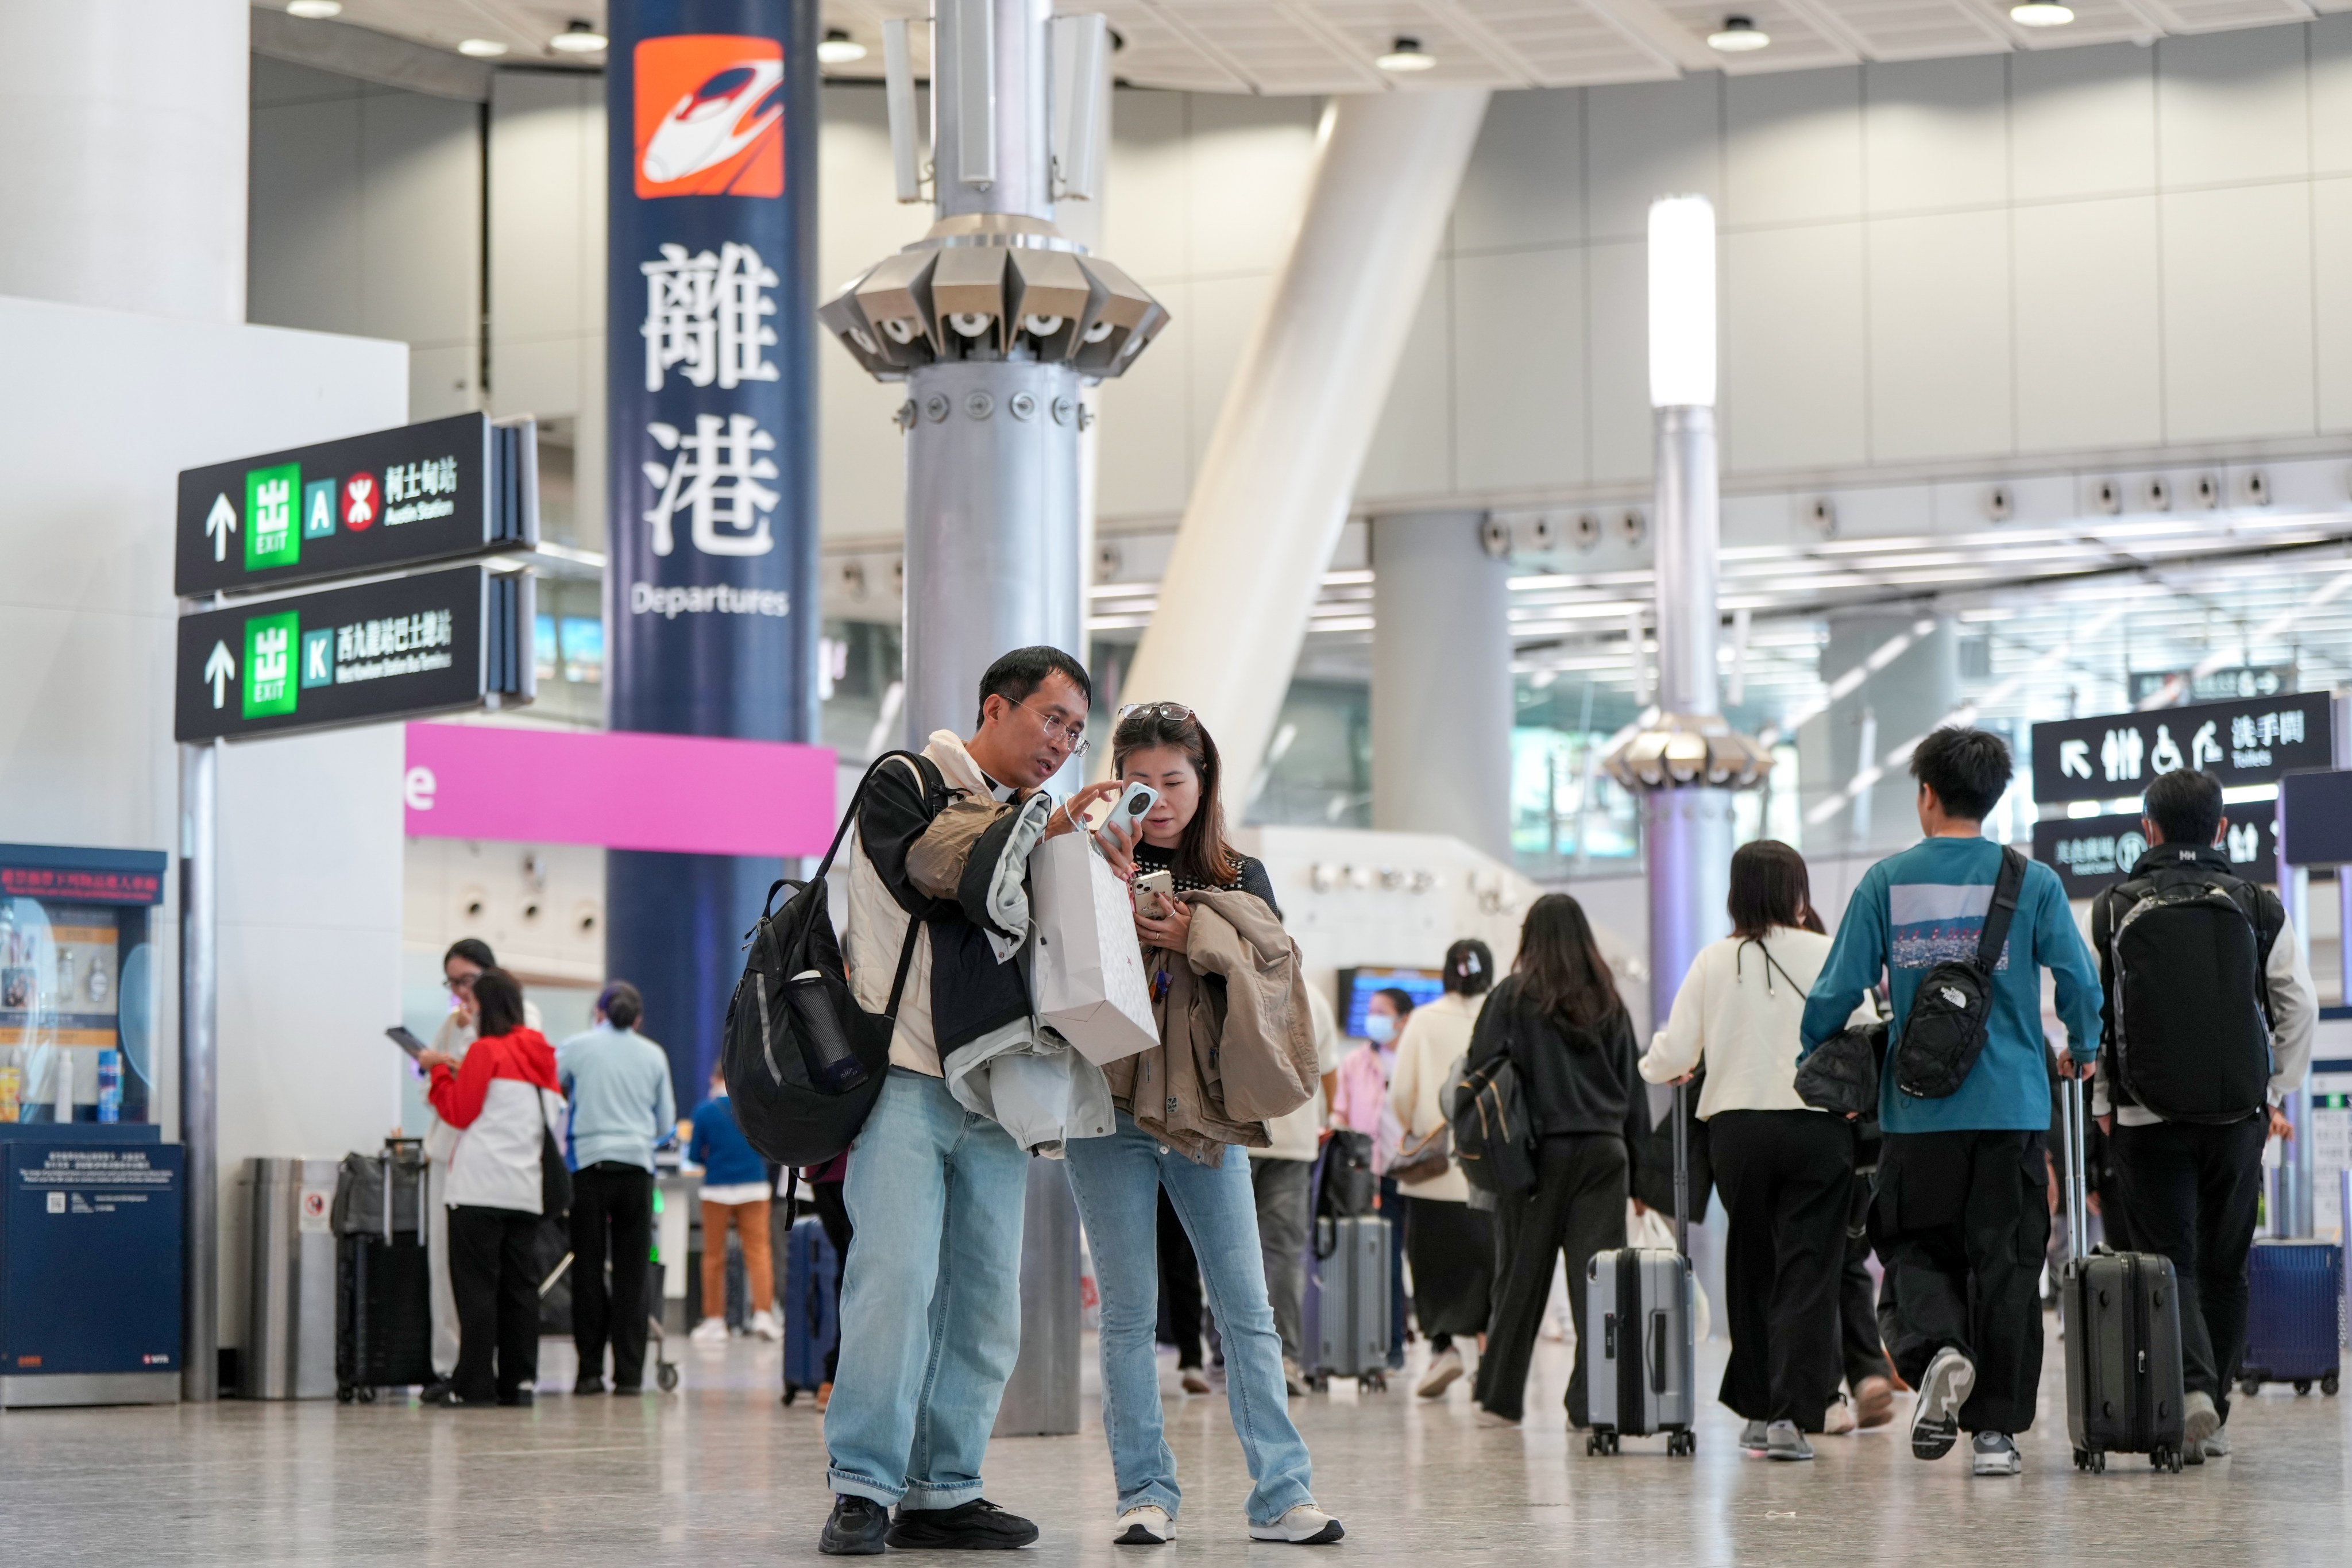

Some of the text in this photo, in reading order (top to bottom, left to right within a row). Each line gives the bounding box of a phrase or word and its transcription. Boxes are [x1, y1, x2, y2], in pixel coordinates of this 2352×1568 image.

[640, 242, 781, 557] 離港
[256, 478, 289, 534] 出
[310, 490, 330, 530] A
[417, 498, 454, 520] Station
[256, 531, 287, 555] EXIT
[631, 582, 790, 619] Departures
[254, 627, 287, 682] 出
[309, 638, 327, 679] K
[254, 679, 286, 702] EXIT
[2231, 709, 2305, 749] 洗手間
[2231, 748, 2273, 768] Toilets
